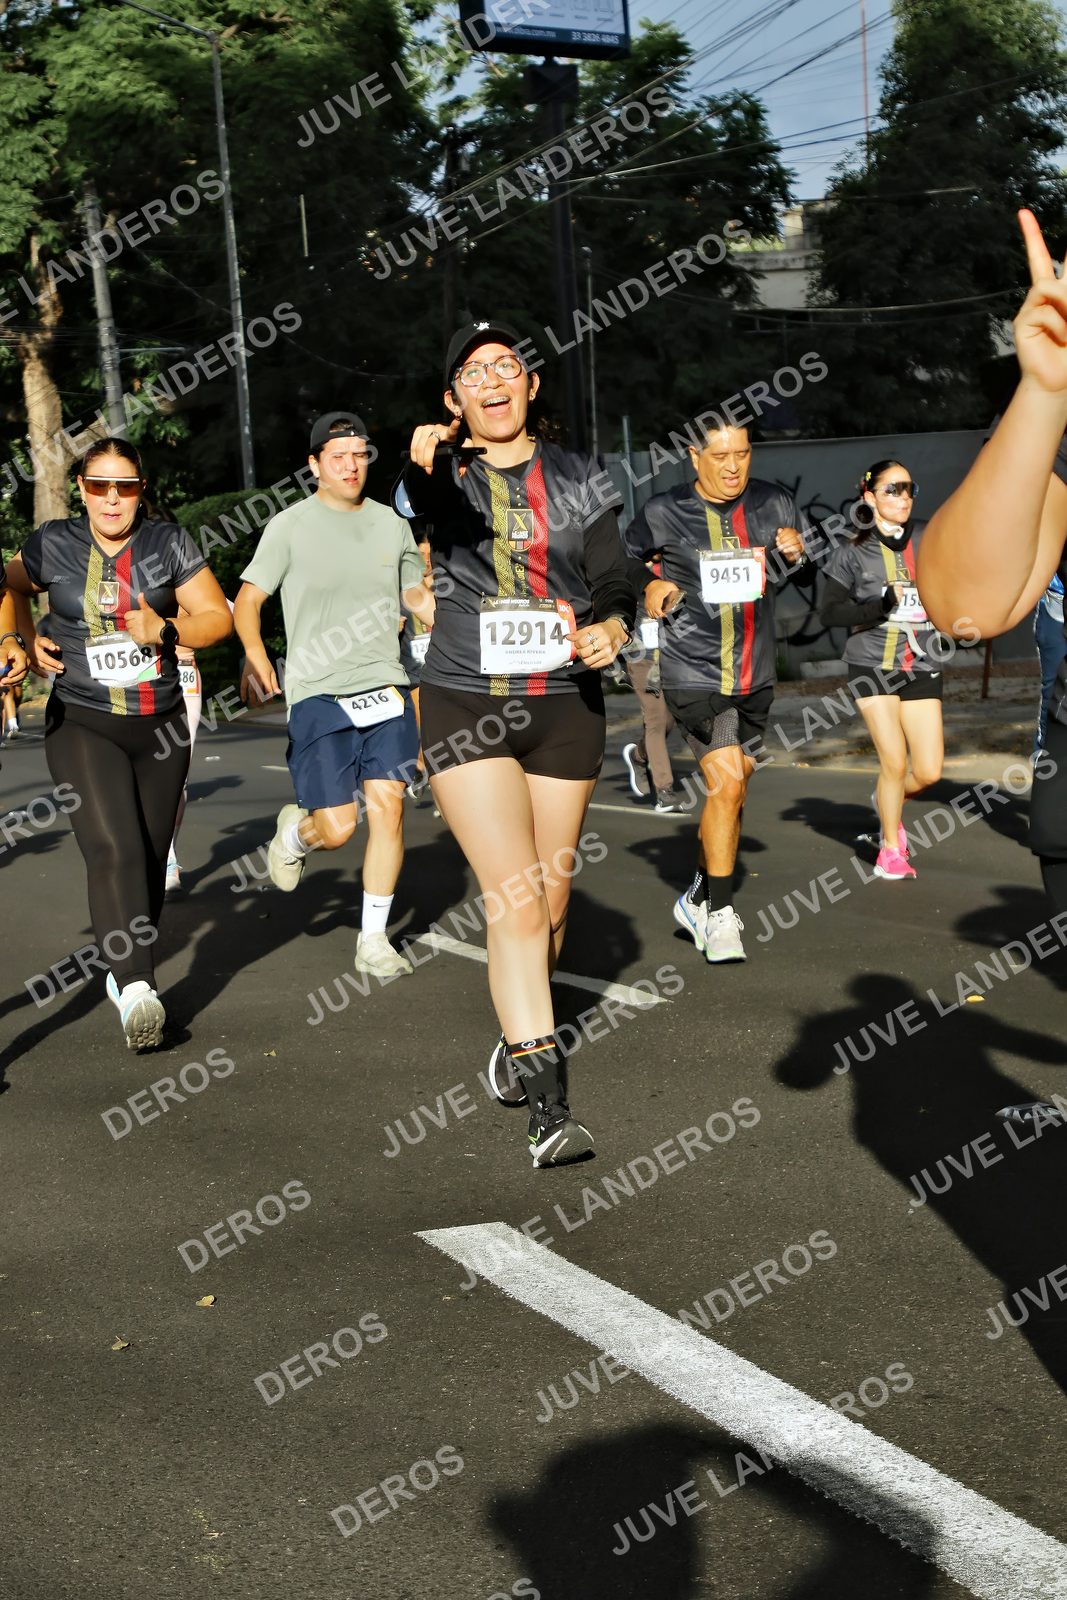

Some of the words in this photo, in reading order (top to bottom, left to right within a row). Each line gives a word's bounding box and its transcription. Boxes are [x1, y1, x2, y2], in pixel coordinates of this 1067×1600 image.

[709, 566, 750, 584] 9451
[485, 620, 564, 646] 12914
[92, 646, 153, 671] 10568
[180, 671, 195, 683] 86
[351, 691, 389, 711] 4216
